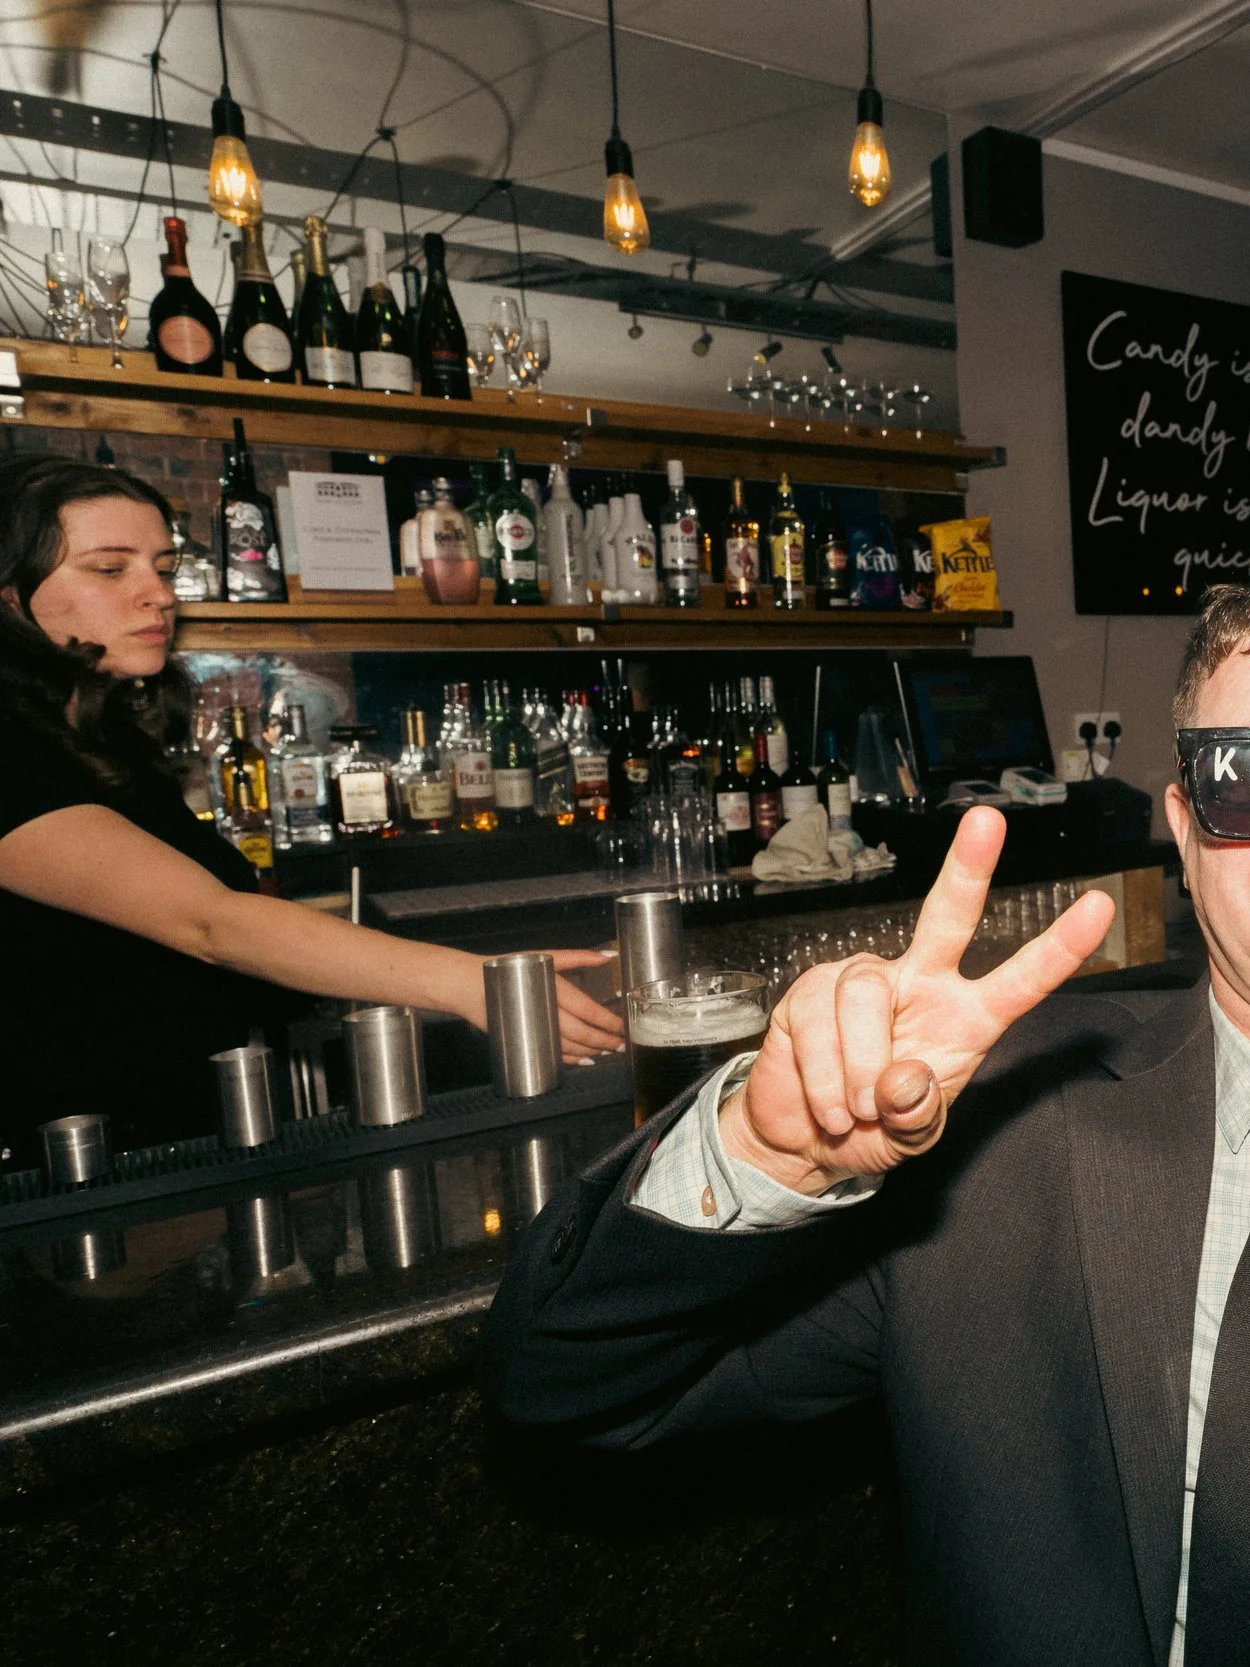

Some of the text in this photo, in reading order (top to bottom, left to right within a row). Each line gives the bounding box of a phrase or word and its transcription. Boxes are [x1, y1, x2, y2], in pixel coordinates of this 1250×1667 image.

[1087, 310, 1219, 401] Candy
[1121, 391, 1236, 479] dandy
[1088, 457, 1208, 534] Liquor
[941, 550, 994, 574] KETTLE
[1214, 746, 1238, 782] K
